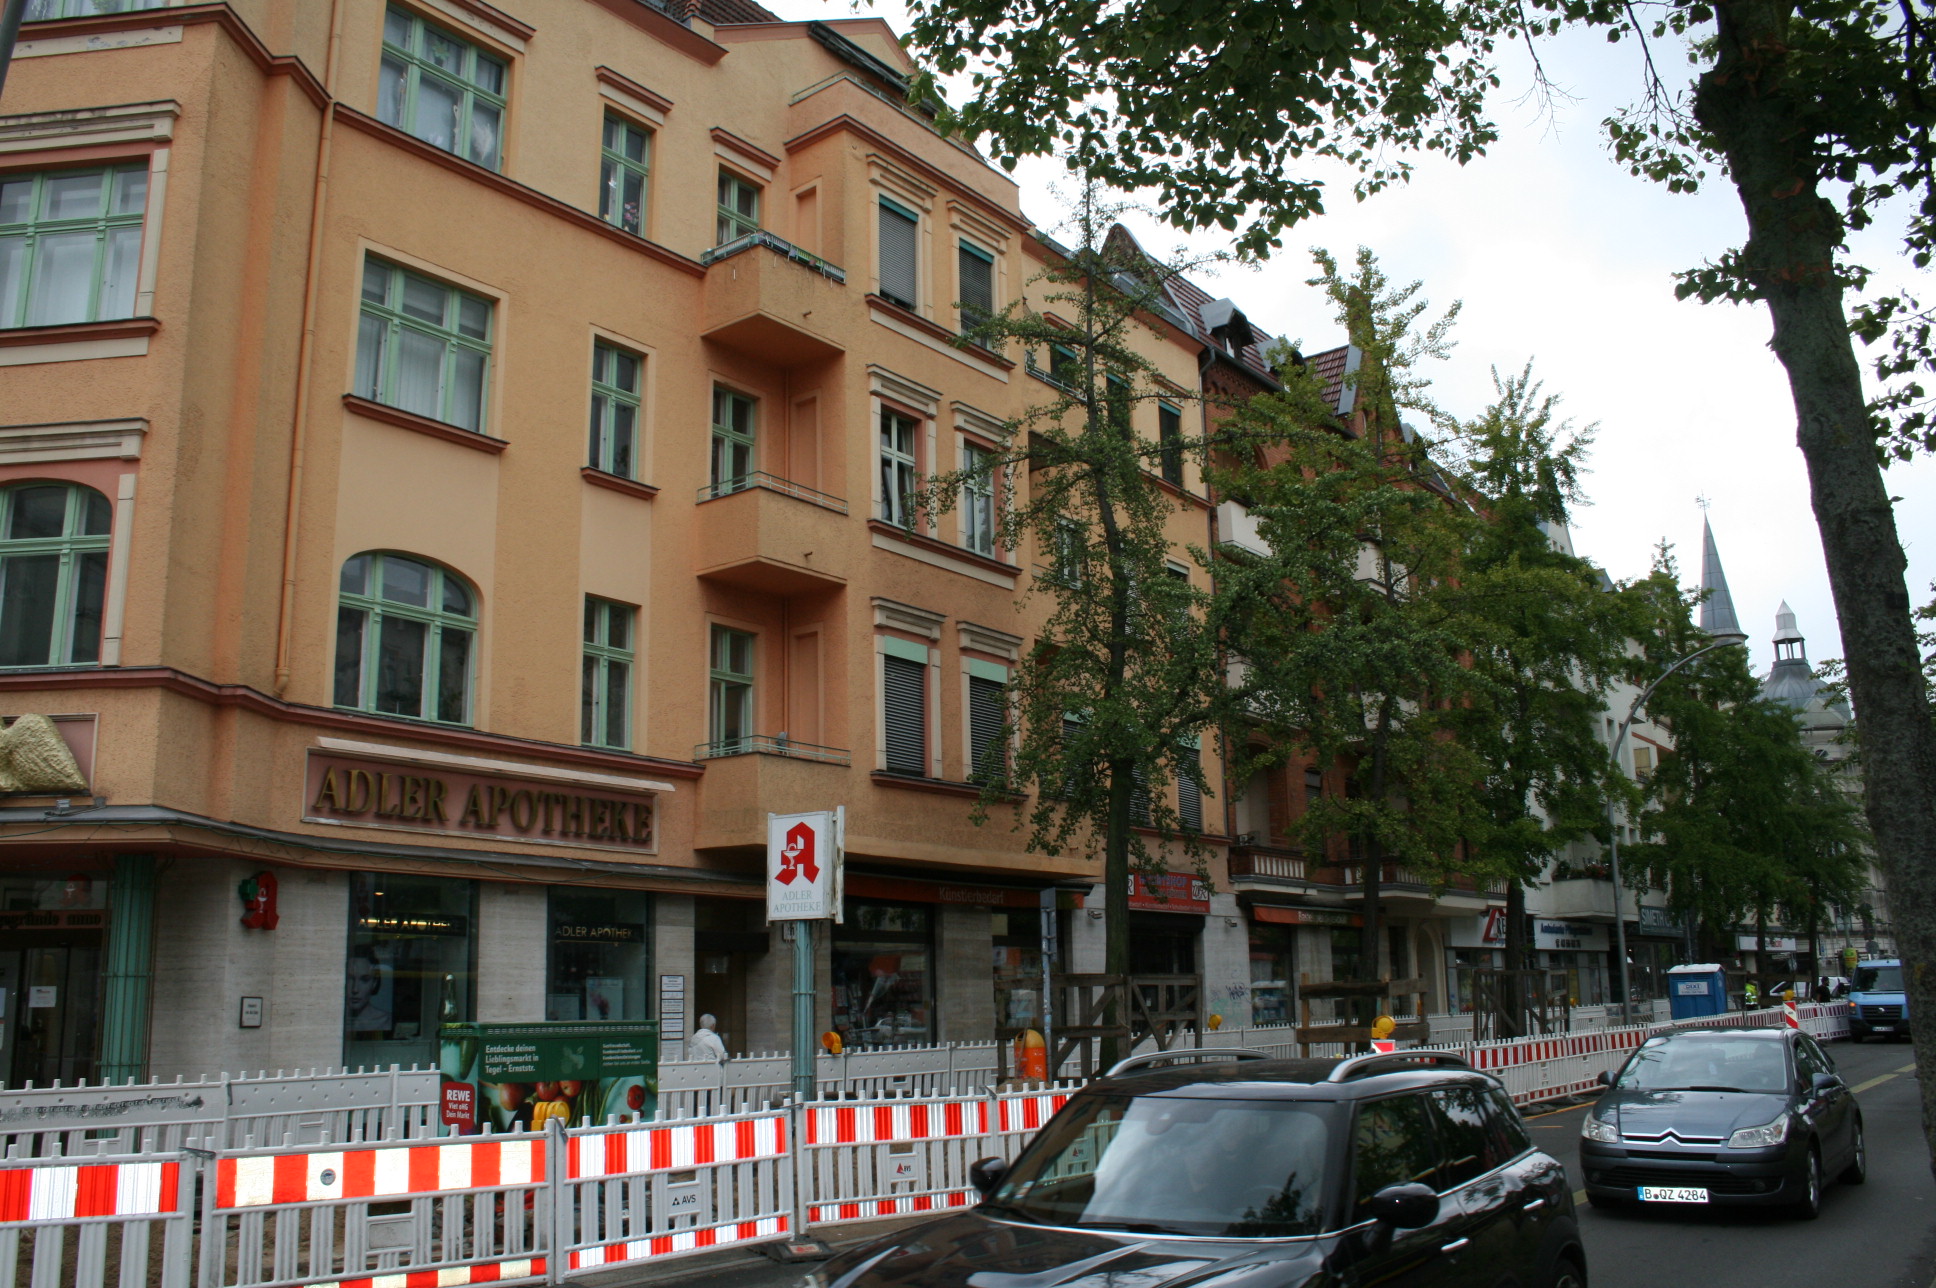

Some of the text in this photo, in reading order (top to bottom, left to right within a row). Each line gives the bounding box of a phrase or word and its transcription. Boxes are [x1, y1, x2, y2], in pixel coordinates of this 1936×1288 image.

[312, 765, 654, 842] ADLER APOTHEKE
[782, 890, 812, 901] ADLER
[938, 887, 1004, 904] Künstlerbedarf
[773, 901, 821, 913] APOTHEKE
[358, 918, 398, 930] ADLER
[555, 926, 587, 938] ADLER
[485, 1044, 536, 1053] Entdecke deinen
[485, 1054, 531, 1064] Lieblingsmarkt
[485, 1064, 502, 1075] Tegel
[508, 1064, 536, 1072] Ernststr.
[446, 1090, 471, 1101] REWE
[446, 1110, 470, 1119] Dein Markt
[681, 1195, 696, 1205] AVS
[1644, 1188, 1707, 1201] B QZ 4284
